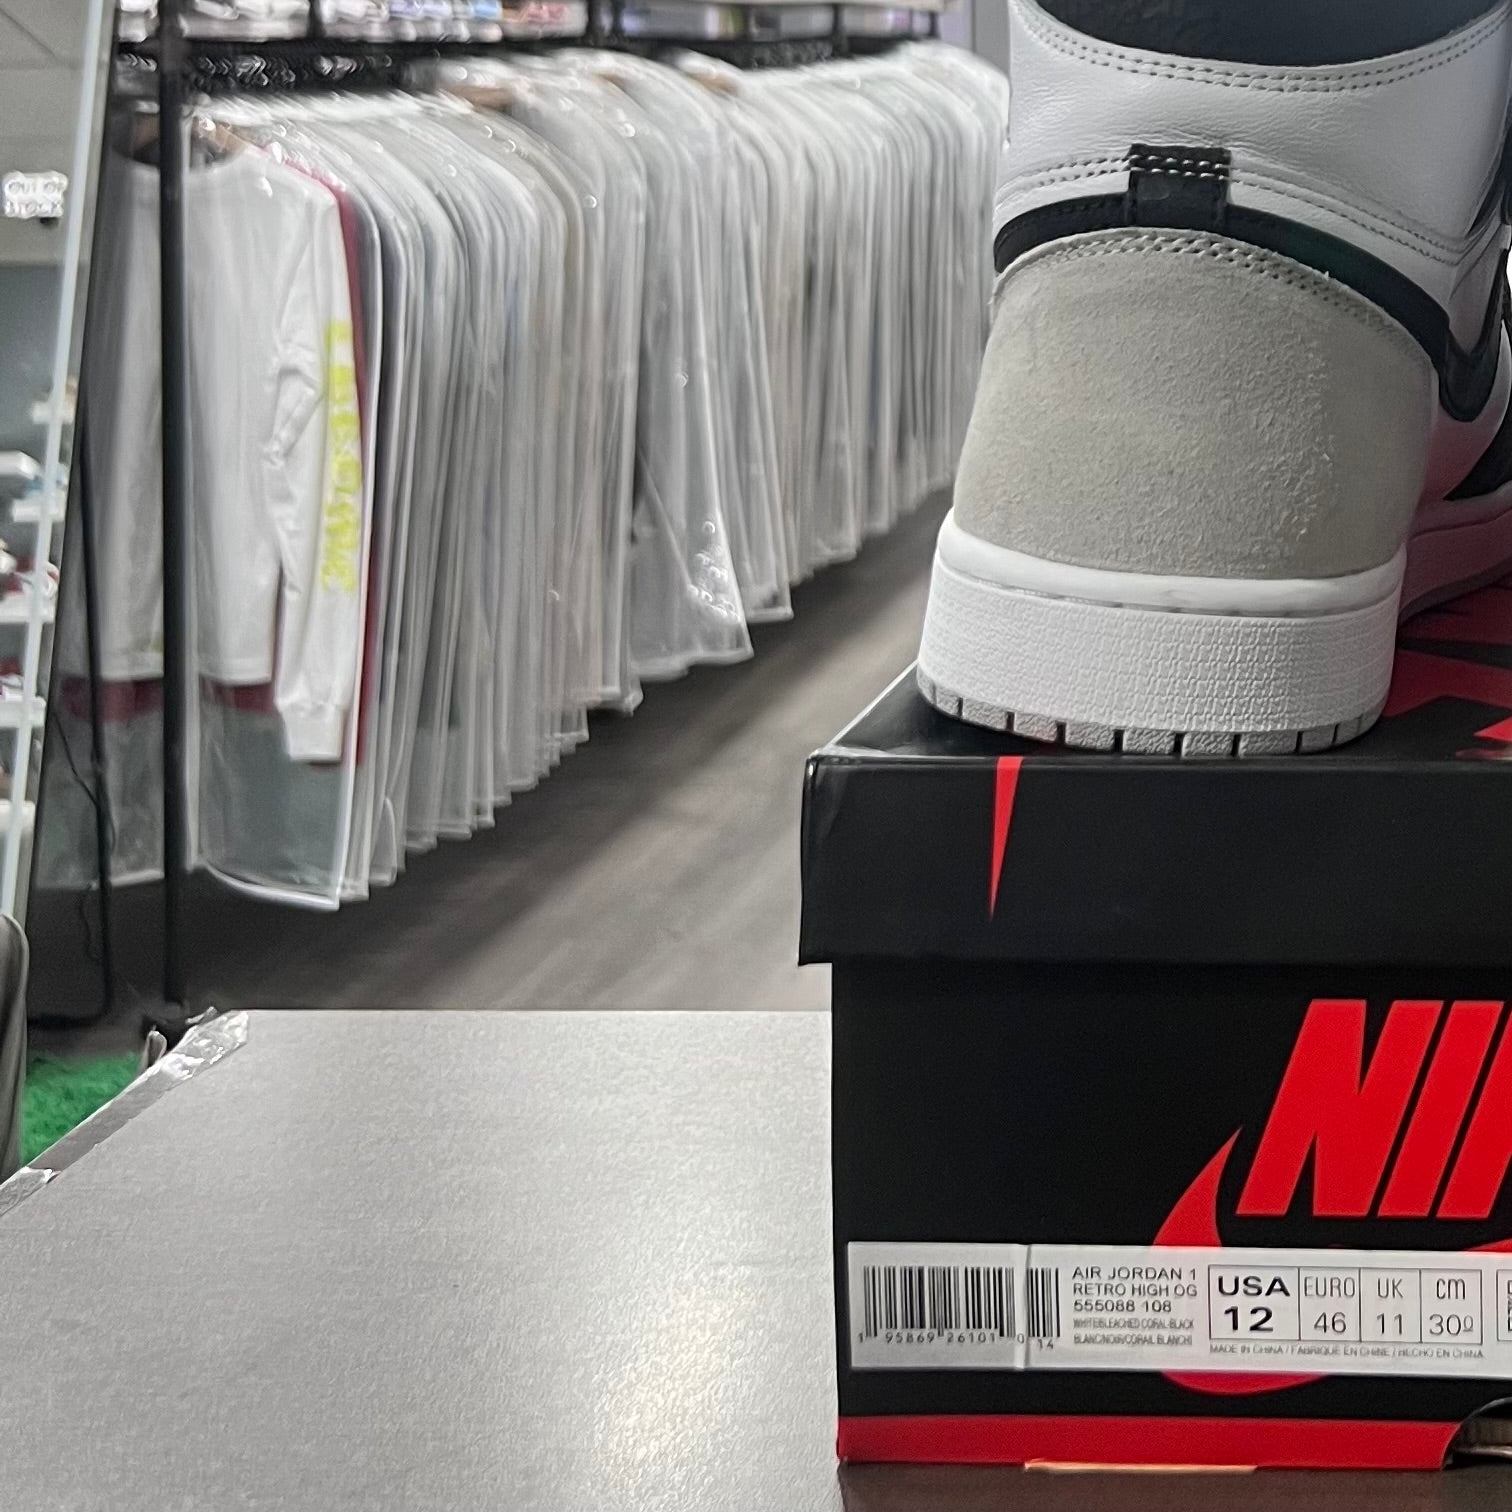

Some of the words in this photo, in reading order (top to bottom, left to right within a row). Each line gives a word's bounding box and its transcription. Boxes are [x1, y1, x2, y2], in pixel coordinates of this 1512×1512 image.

[1072, 1266, 1102, 1280] AIR
[1108, 1266, 1182, 1281] JORDAN
[1189, 1268, 1197, 1281] 1
[1073, 1283, 1126, 1296] RETRO
[1131, 1284, 1169, 1297] HIGH
[1174, 1284, 1198, 1297] OG
[1218, 1276, 1290, 1297] USA
[1304, 1276, 1356, 1298] EURO
[1377, 1277, 1404, 1299] UK
[1073, 1299, 1136, 1313] 555088
[1144, 1299, 1172, 1313] 108
[1224, 1306, 1274, 1331] 12
[1313, 1311, 1347, 1334] 46
[1377, 1313, 1403, 1335] 11
[885, 1332, 935, 1344] 95869
[947, 1332, 996, 1344] 26101
[1038, 1339, 1054, 1350] 14
[1209, 1344, 1237, 1354] MADE
[1241, 1344, 1251, 1354] IN
[1253, 1345, 1283, 1355] CHINA
[1291, 1345, 1340, 1357] FABRIQUE
[1344, 1346, 1357, 1356] EN
[1360, 1347, 1389, 1357] CHINE
[1437, 1348, 1450, 1358] EN
[1453, 1348, 1484, 1359] CHINA
